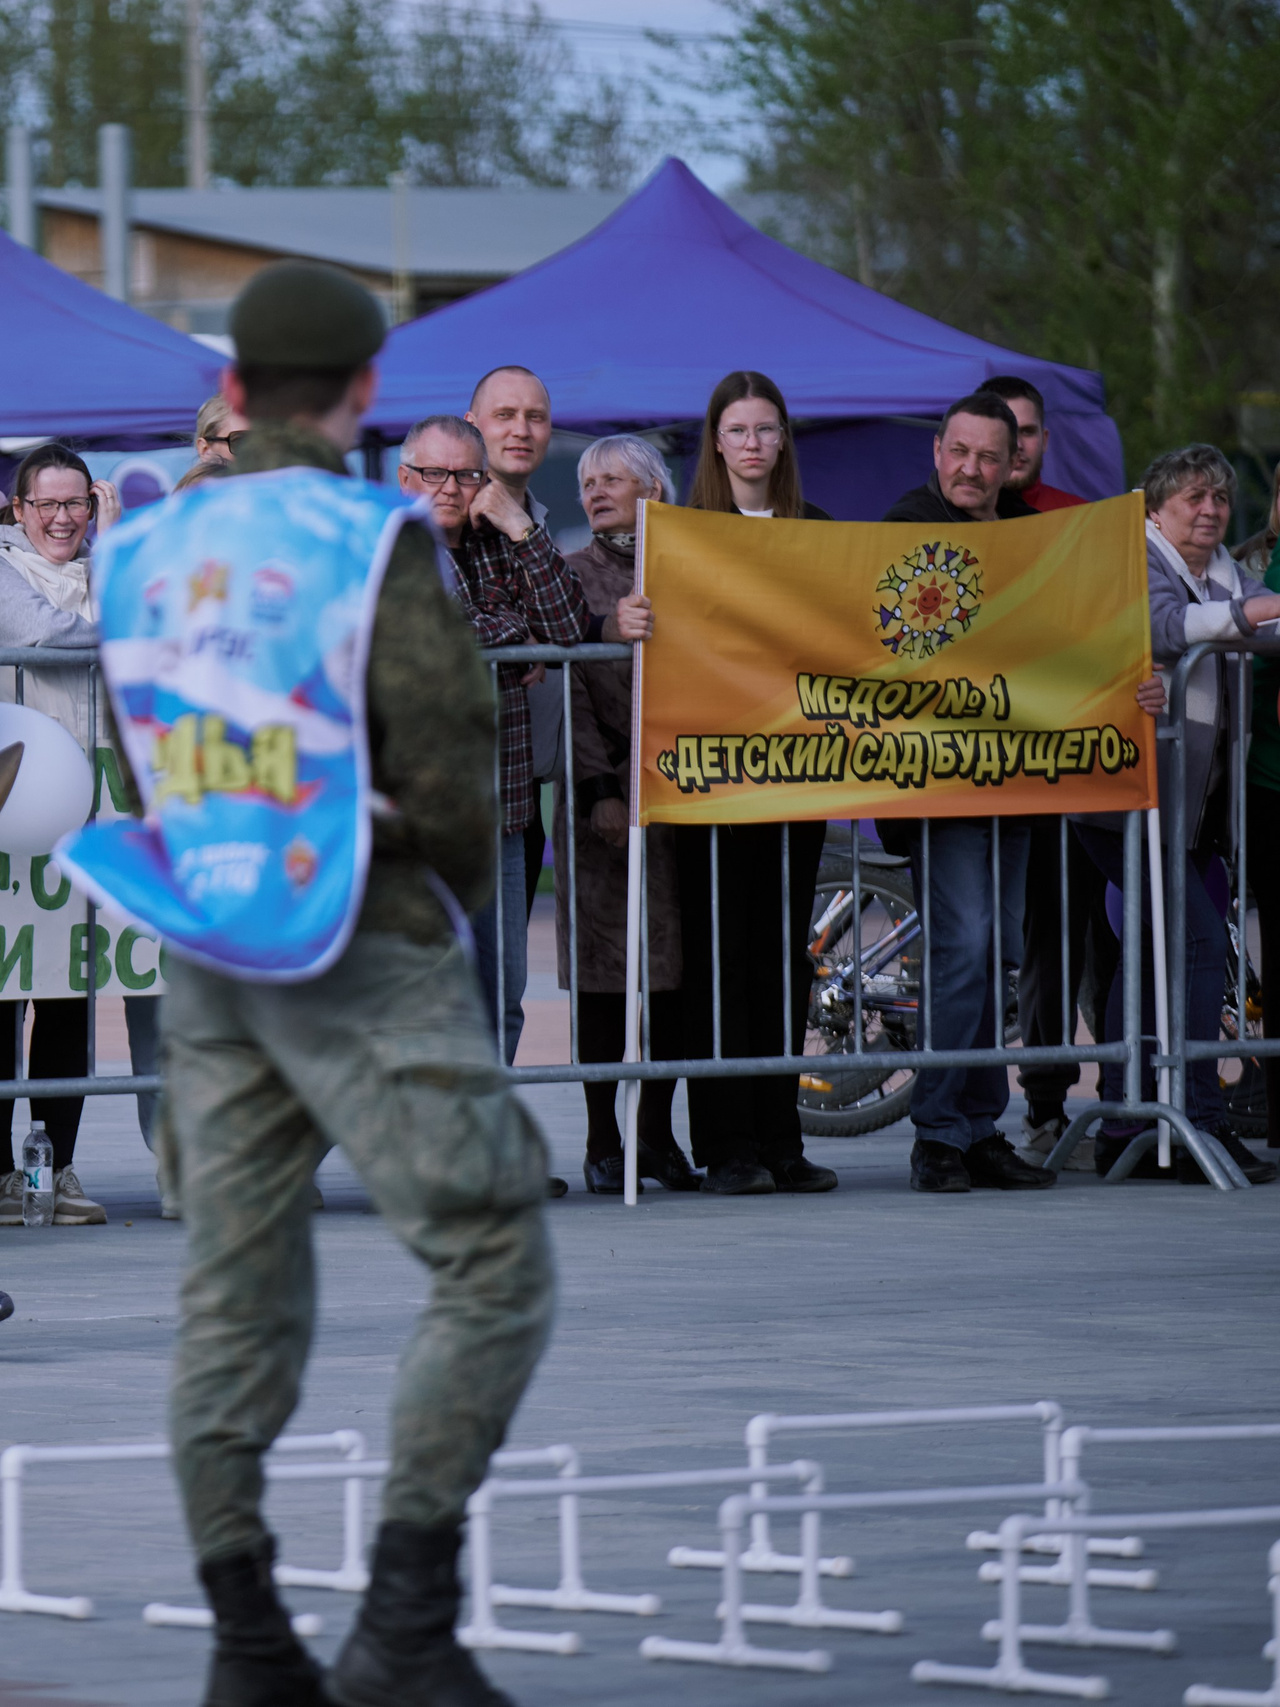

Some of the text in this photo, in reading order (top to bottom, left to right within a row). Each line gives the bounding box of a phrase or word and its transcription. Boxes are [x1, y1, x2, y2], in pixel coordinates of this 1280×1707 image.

[797, 673, 940, 728] МБДОУ
[657, 723, 1139, 793] «ДЕТСКИЙ САД БУДУЩЕГО»
